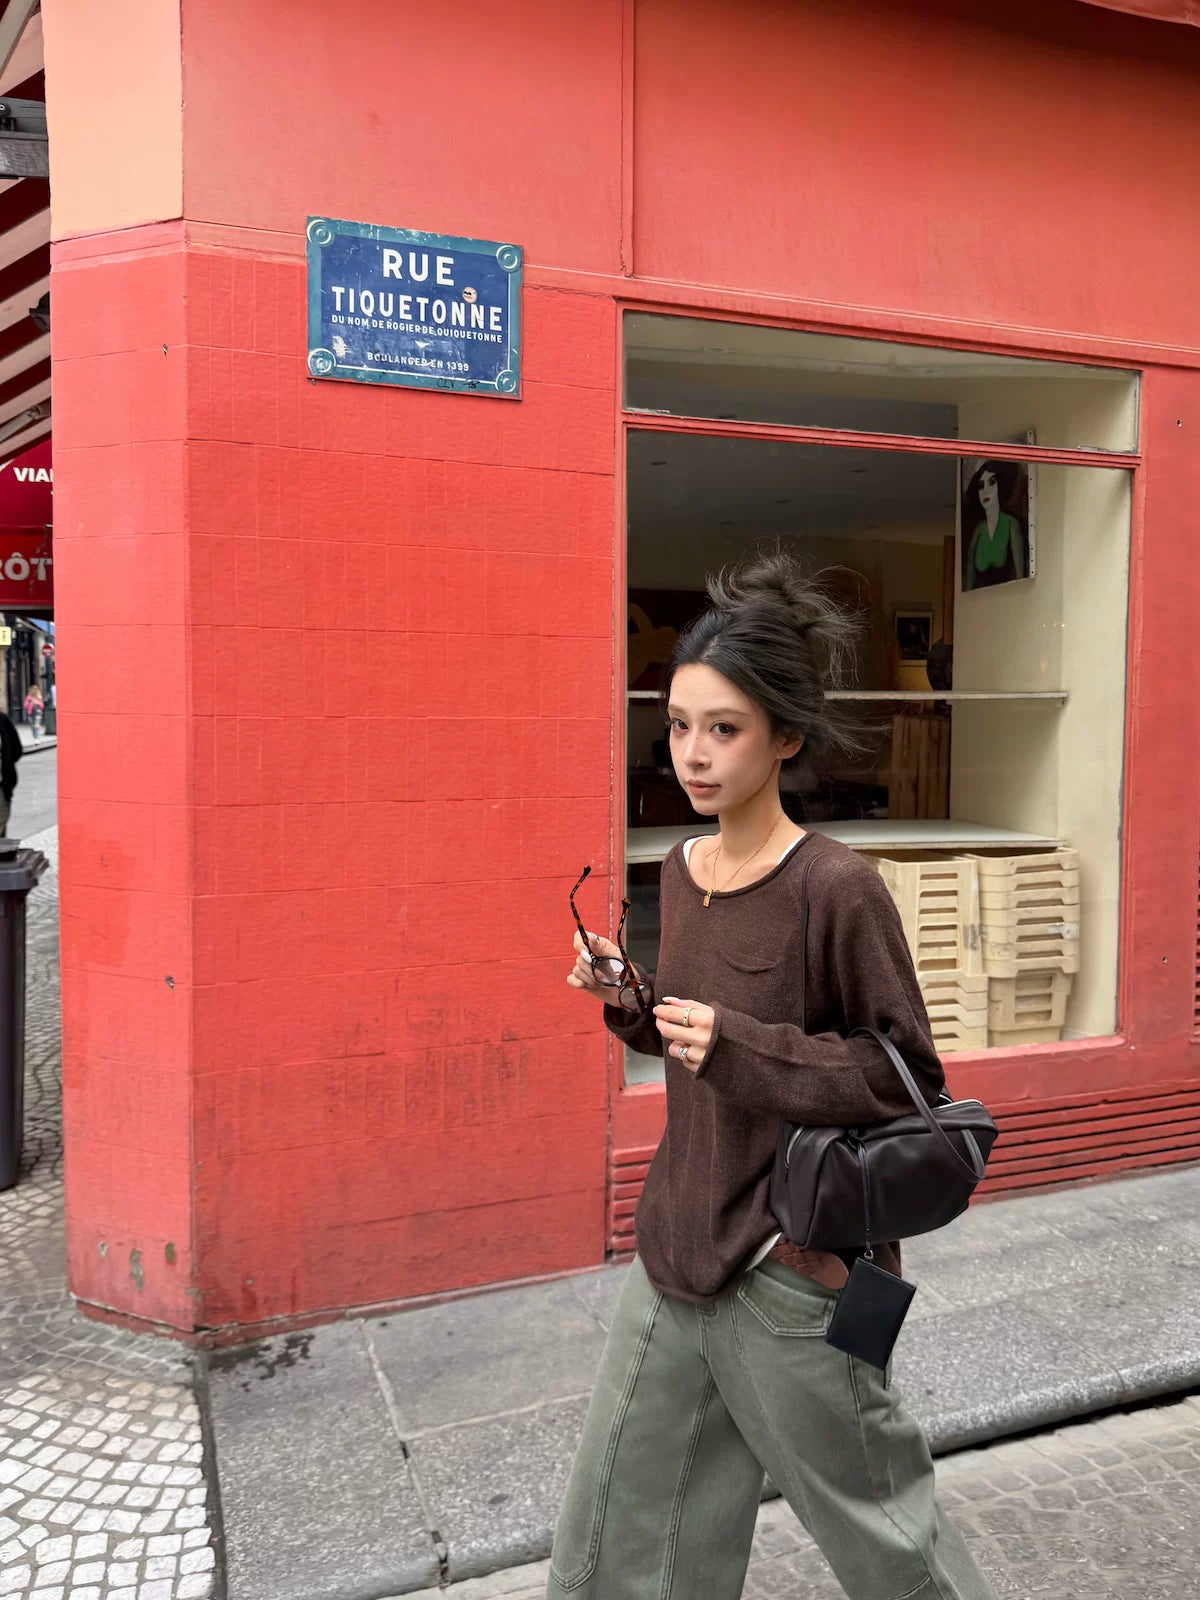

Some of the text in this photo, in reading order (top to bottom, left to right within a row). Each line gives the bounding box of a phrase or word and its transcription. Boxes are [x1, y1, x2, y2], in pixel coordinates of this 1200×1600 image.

[383, 248, 455, 287] RUE
[331, 286, 503, 332] TIQUETONNE
[331, 314, 502, 343] DU NOM DE ROGIER DE QUIQUETONNE
[430, 358, 444, 369] EN
[446, 361, 470, 372] 1399
[13, 467, 53, 482] VIA
[0, 551, 52, 581] ÔT
